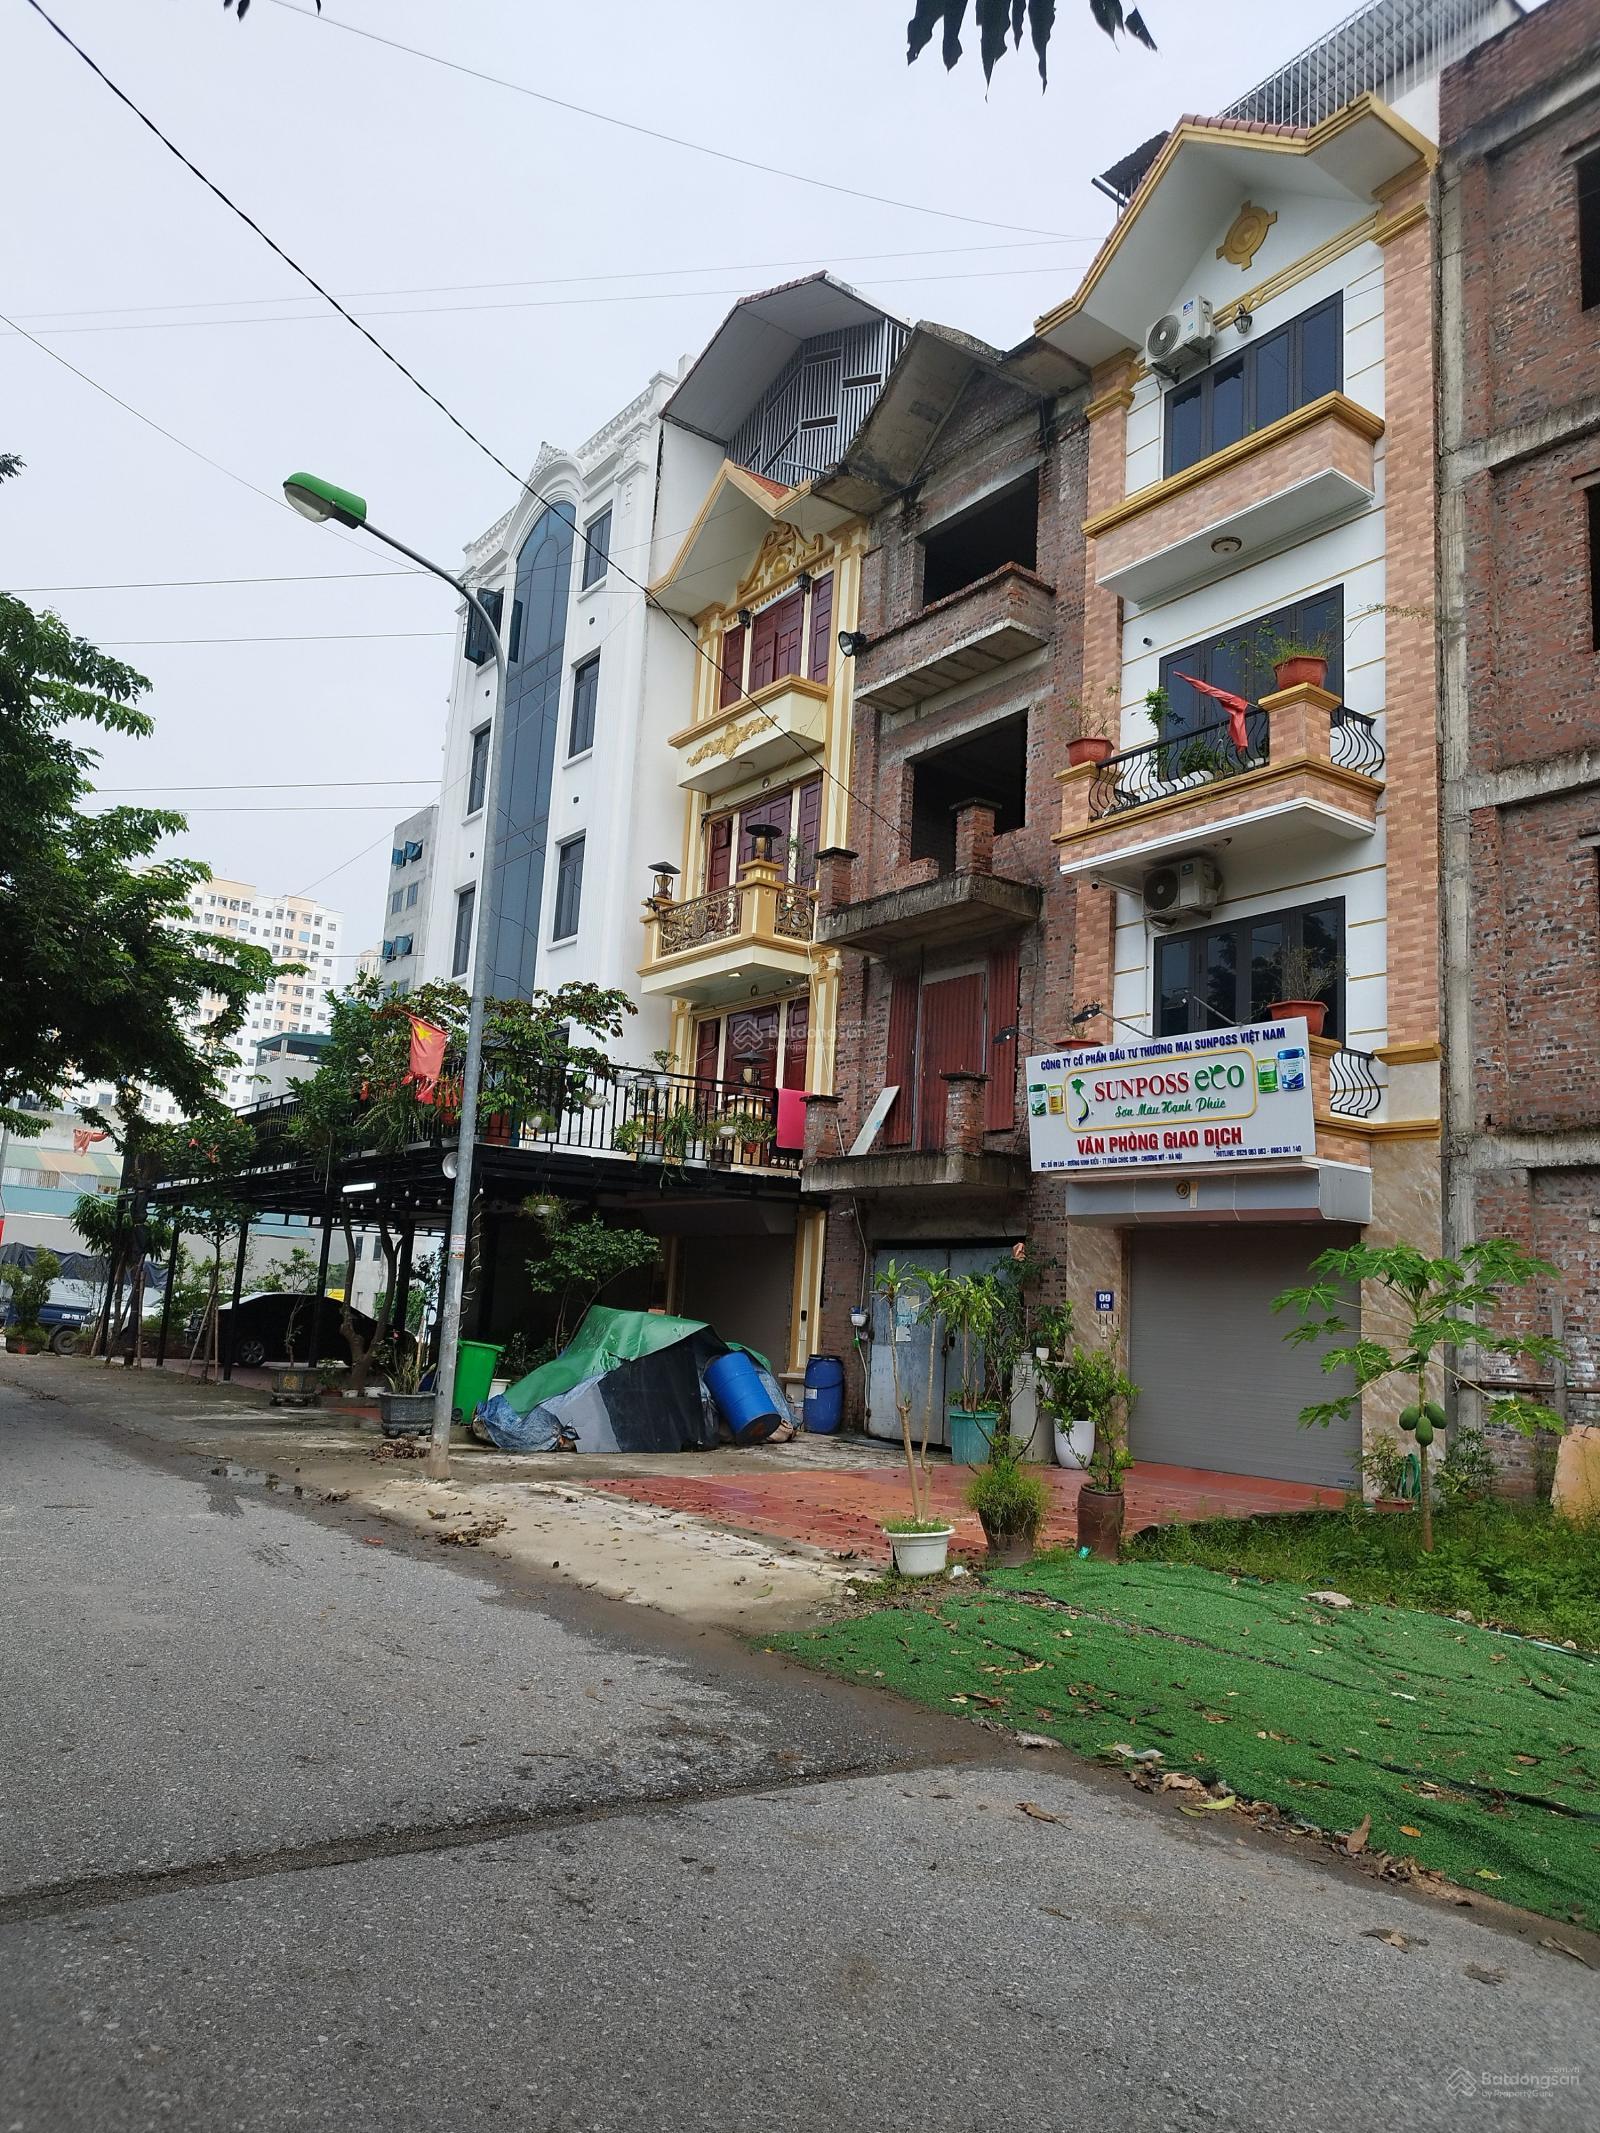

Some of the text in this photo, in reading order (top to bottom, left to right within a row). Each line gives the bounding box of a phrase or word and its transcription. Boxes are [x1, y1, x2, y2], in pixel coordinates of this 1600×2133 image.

[1041, 1059, 1061, 1070] CÔNG
[1063, 1058, 1071, 1068] TY
[1073, 1052, 1084, 1065] CỔ
[1127, 1047, 1138, 1059] TƯ
[1139, 1043, 1172, 1057] THƯƠNG
[1175, 1041, 1192, 1054] MẠI
[1195, 1033, 1238, 1050] SUNPOSS
[1240, 1029, 1260, 1045] VIỆT
[1262, 1027, 1286, 1040] NAM
[1094, 1072, 1189, 1102] SUNPOSS
[1194, 1064, 1245, 1091] eco
[1161, 1099, 1192, 1114] Hạnh
[1077, 1127, 1243, 1155] VĂN PHÒNG GIAO DỊCH
[1099, 1293, 1111, 1302] 09
